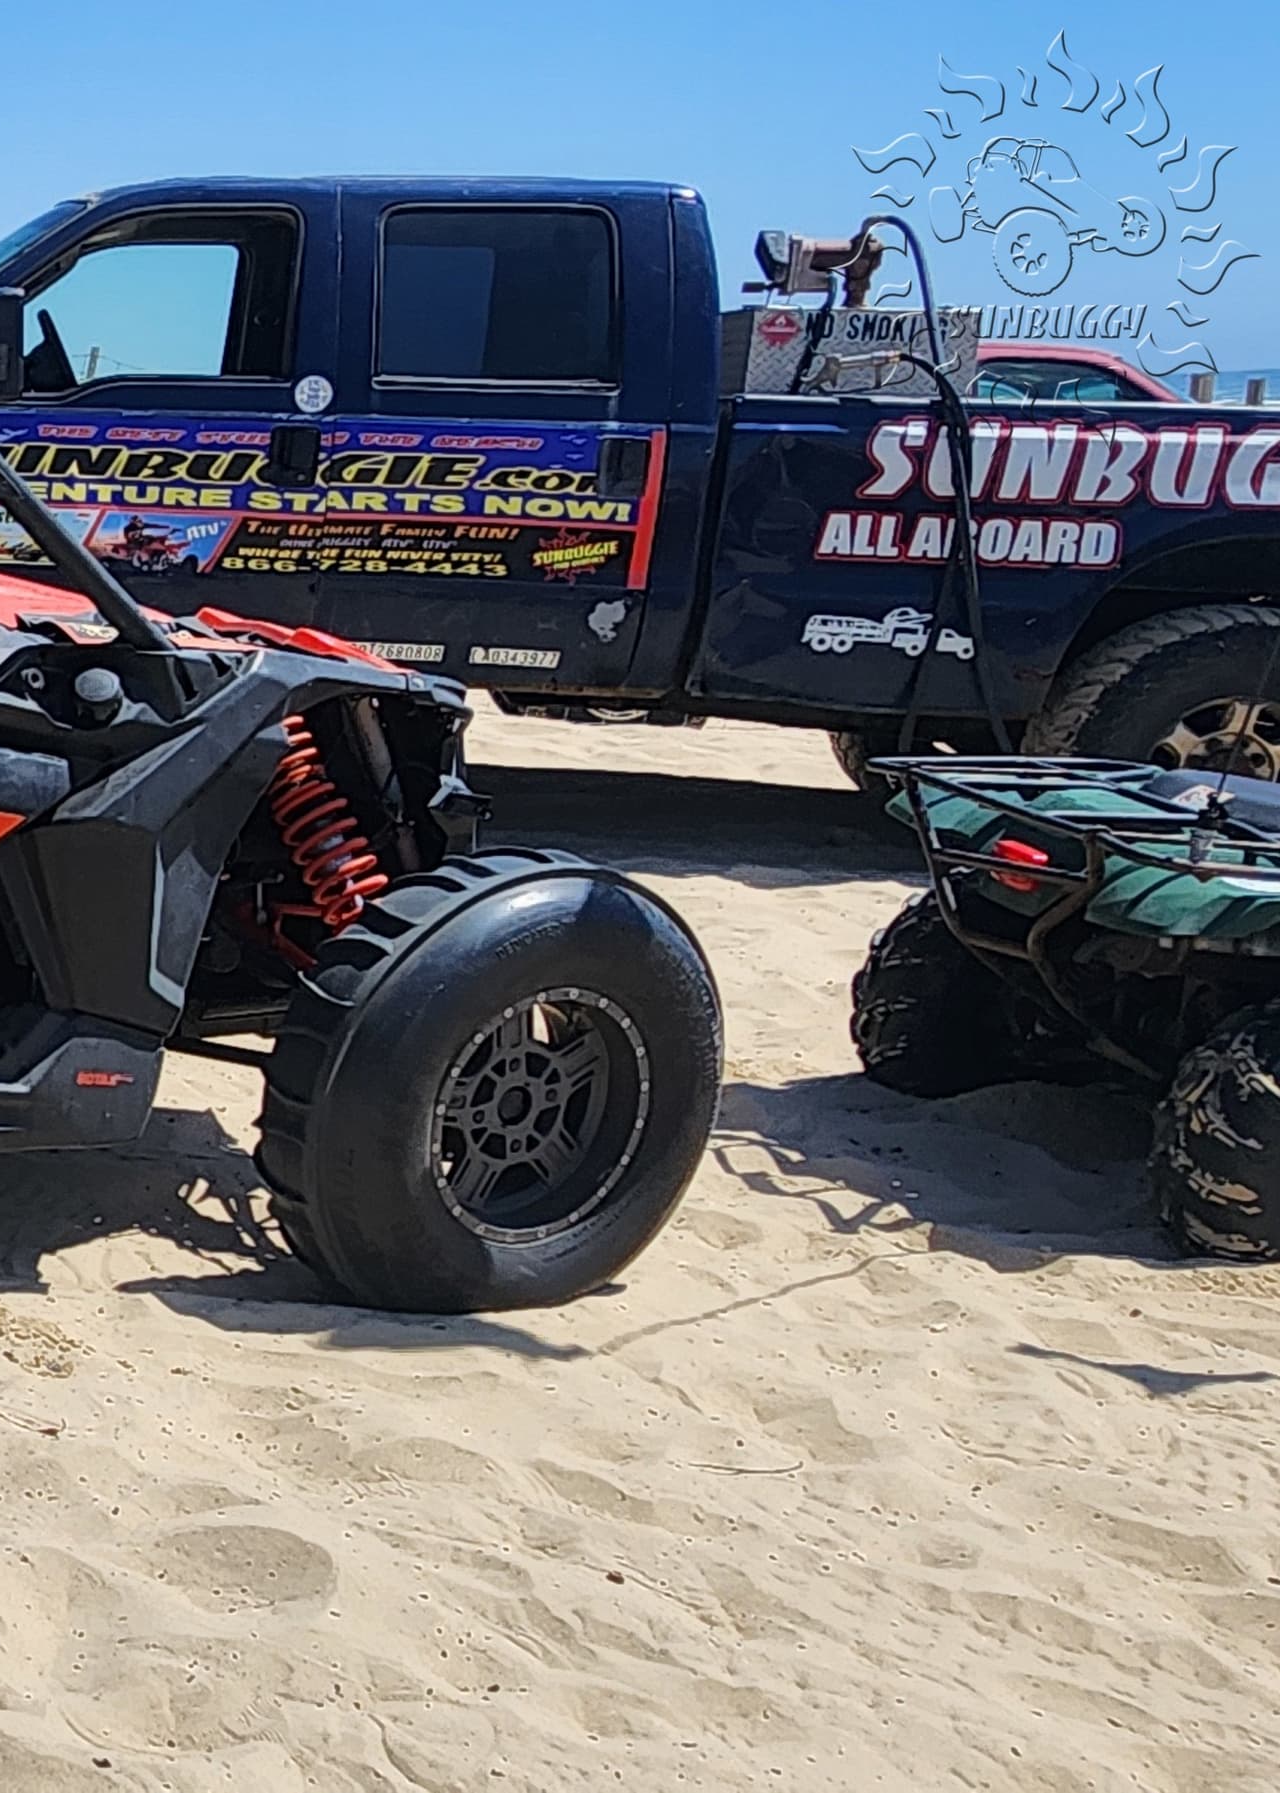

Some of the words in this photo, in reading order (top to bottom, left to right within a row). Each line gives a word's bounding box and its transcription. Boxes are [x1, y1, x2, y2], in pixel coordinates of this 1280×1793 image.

[248, 489, 465, 515] STARTS
[482, 494, 630, 522] NOW!
[454, 525, 520, 540] FUN!
[818, 513, 898, 557] ALL
[222, 557, 508, 577] 866-728-4443
